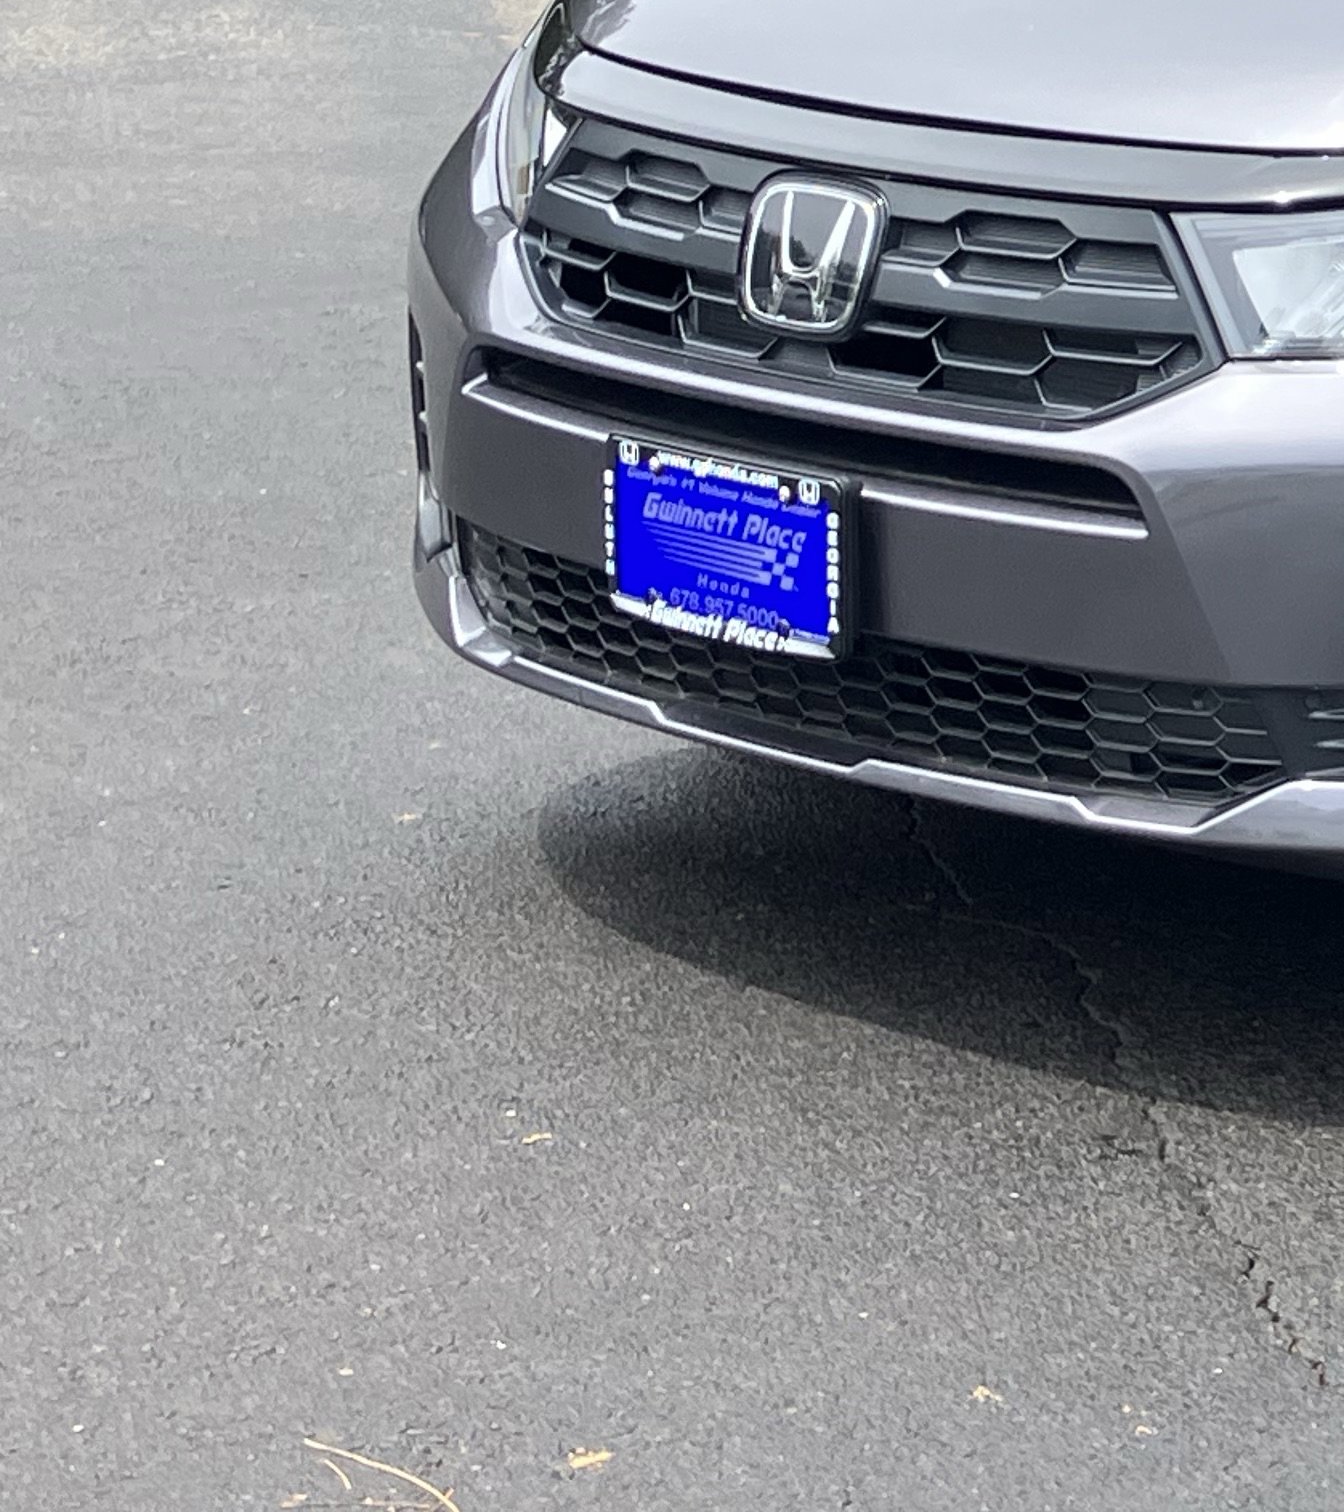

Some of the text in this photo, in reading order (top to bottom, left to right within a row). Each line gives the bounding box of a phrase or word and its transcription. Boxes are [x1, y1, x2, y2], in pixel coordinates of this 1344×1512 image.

[643, 491, 808, 553] Gwinnett Place
[697, 572, 749, 599] Honda
[826, 512, 840, 634] GEORGIA
[651, 599, 779, 651] Gwinnett Place
[670, 587, 779, 632] 678.9575000
